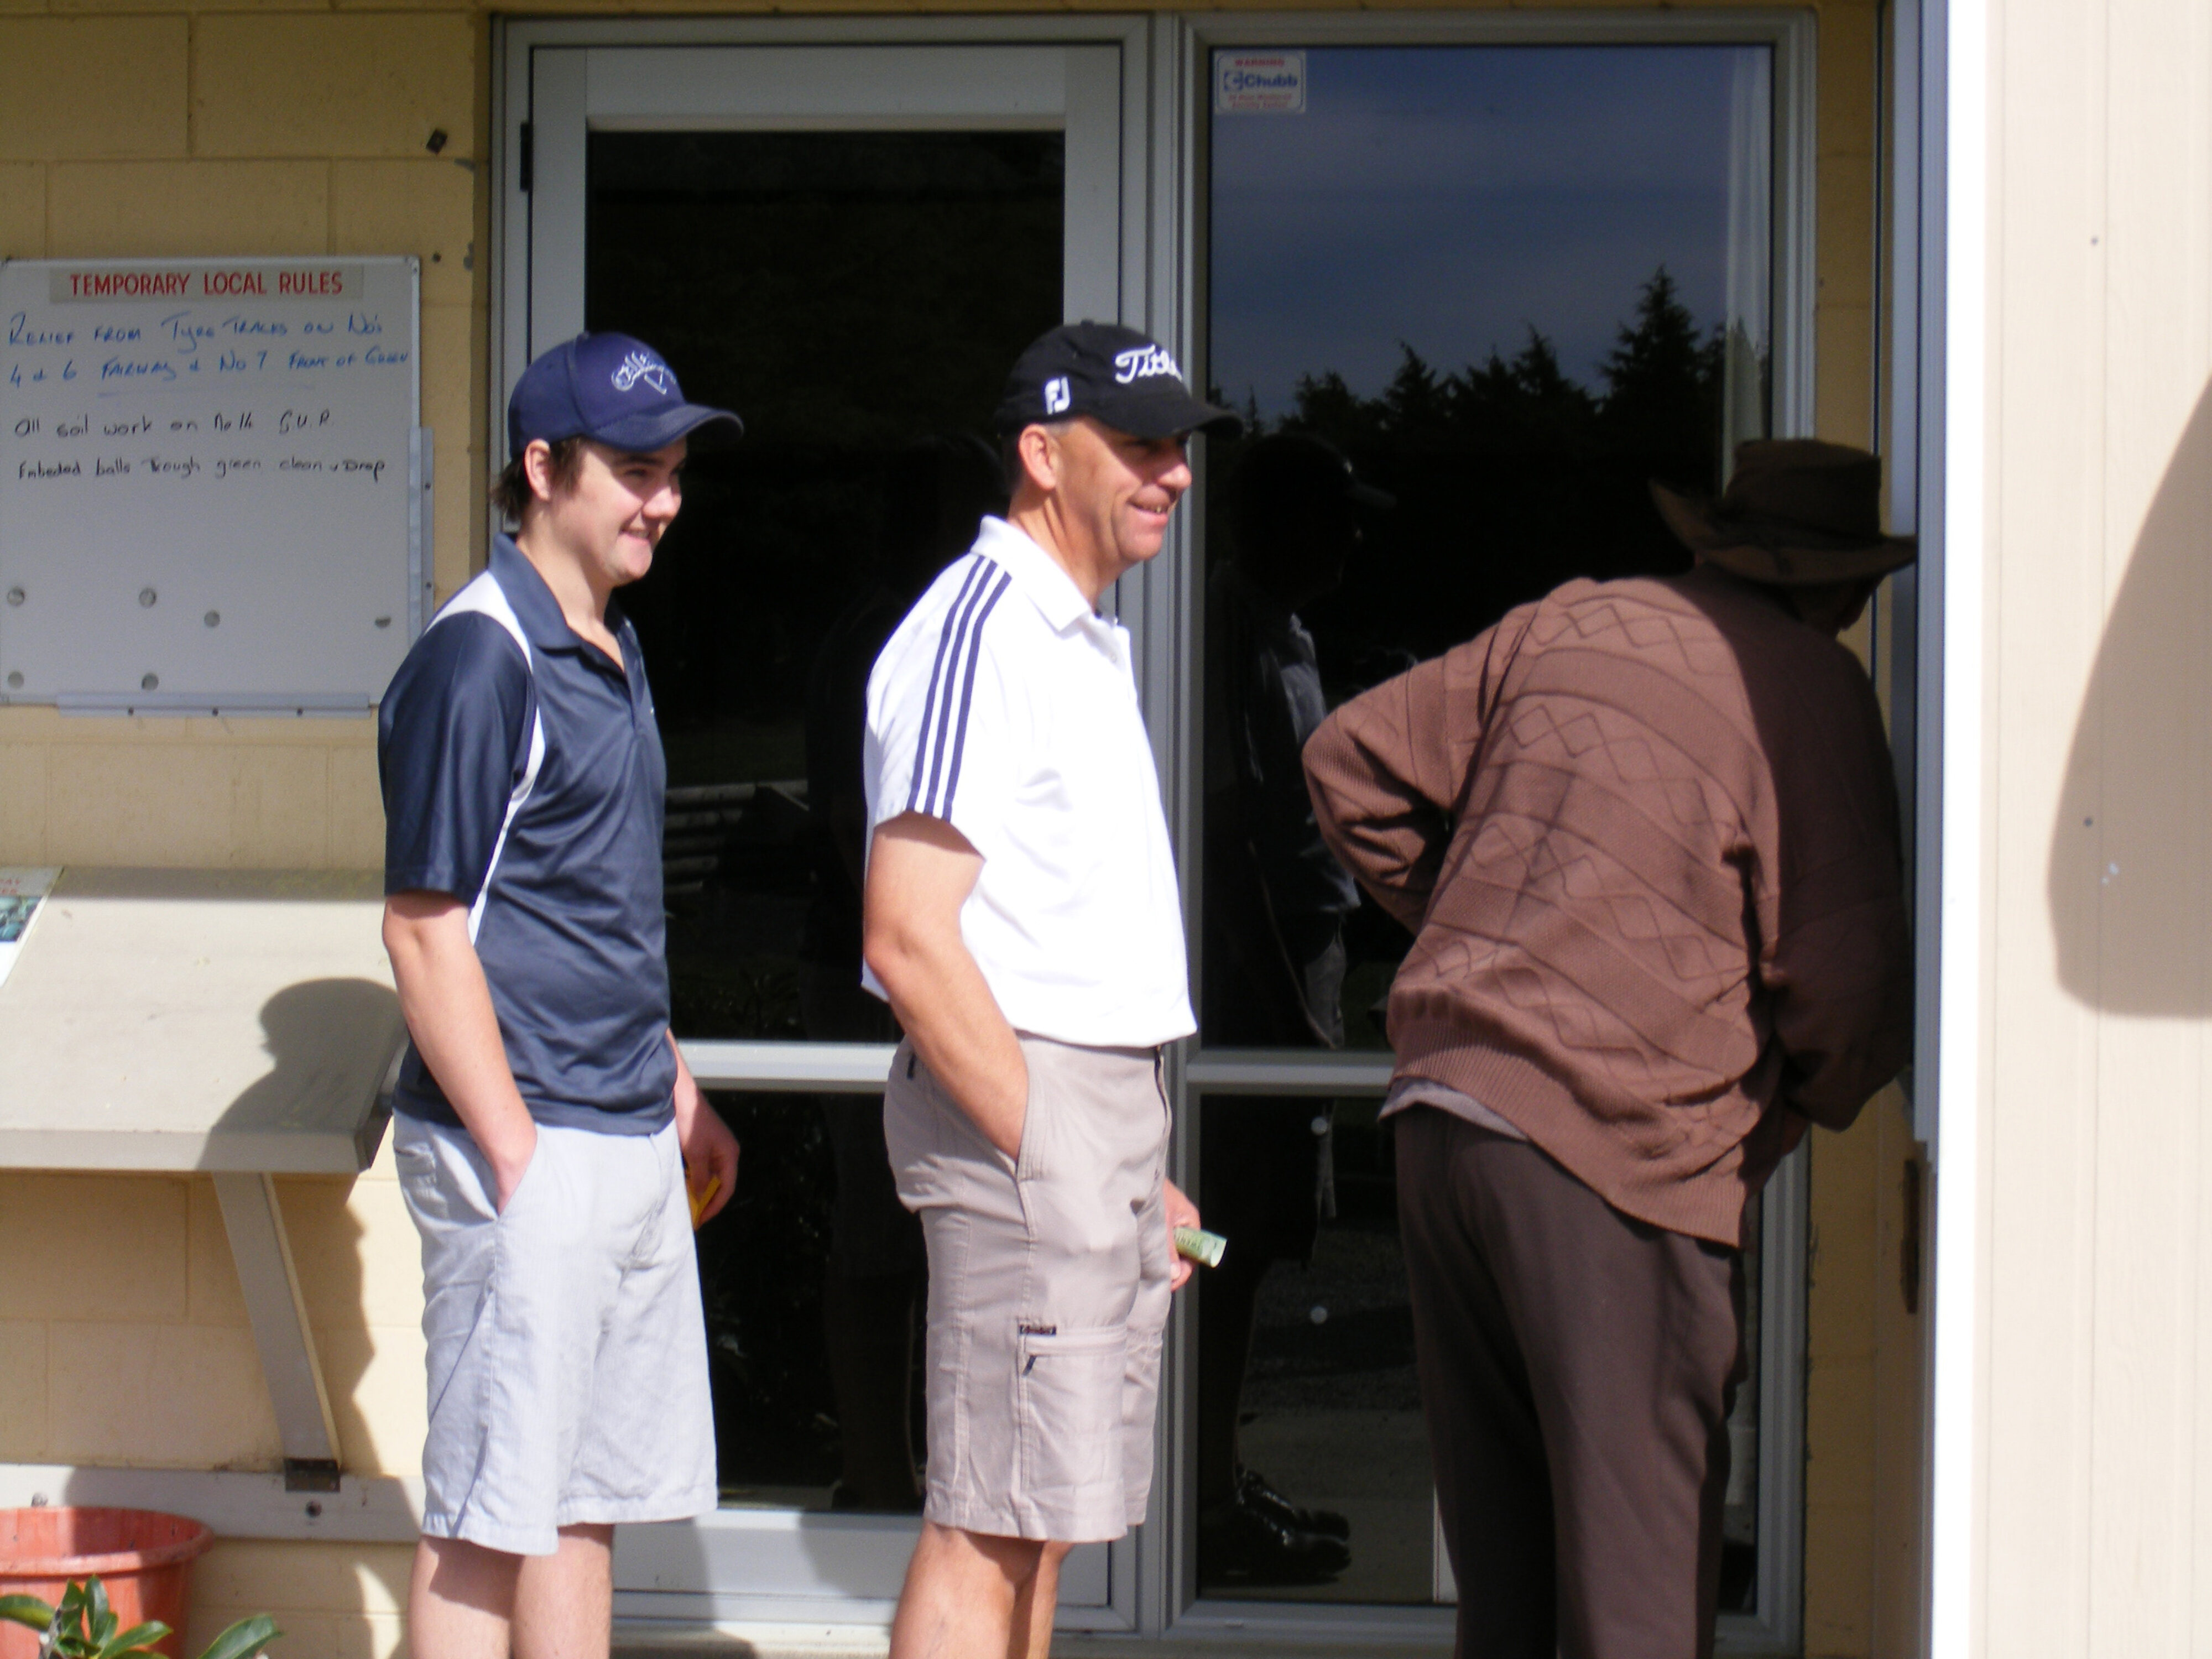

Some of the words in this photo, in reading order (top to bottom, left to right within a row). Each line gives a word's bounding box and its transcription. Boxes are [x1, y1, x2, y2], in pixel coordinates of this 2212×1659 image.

[1244, 73, 1298, 87] Chubb
[70, 272, 190, 296] TEMPORARY
[204, 272, 267, 295] LOCAL
[279, 271, 343, 295] RULES
[10, 363, 22, 388] 4
[62, 358, 77, 381] 6
[257, 349, 268, 371] 7
[56, 411, 88, 438] soil
[103, 414, 153, 436] work
[170, 420, 199, 432] on
[96, 456, 131, 478] balls
[215, 458, 262, 479] green
[279, 455, 322, 472] clean
